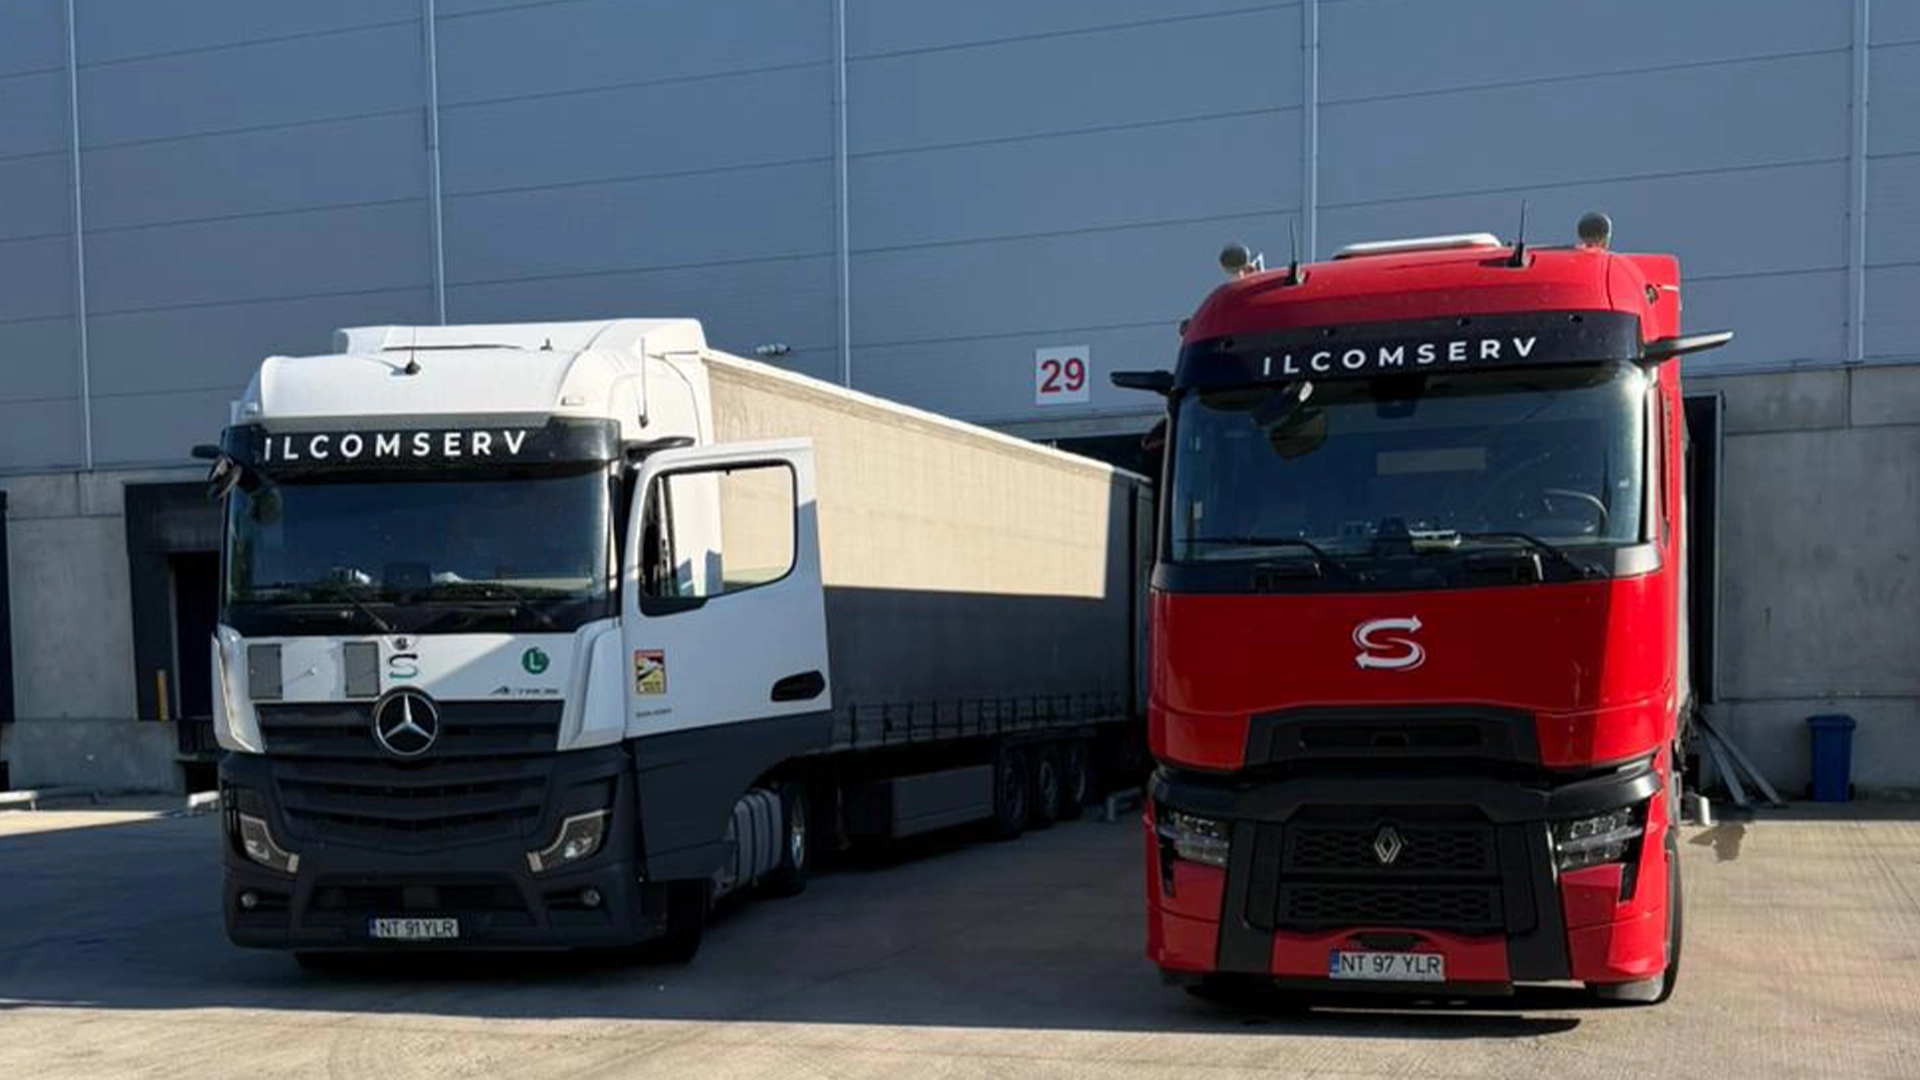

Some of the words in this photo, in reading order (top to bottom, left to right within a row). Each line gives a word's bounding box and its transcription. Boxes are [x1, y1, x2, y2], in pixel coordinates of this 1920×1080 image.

[1262, 337, 1537, 376] ILCOMSERV
[1041, 357, 1086, 393] 29
[263, 430, 526, 462] ILCOMSERV
[379, 920, 399, 936] NT
[422, 920, 455, 937] YLR
[1342, 954, 1366, 973] NT
[1373, 954, 1395, 974] 97
[1402, 955, 1441, 975] YLR
